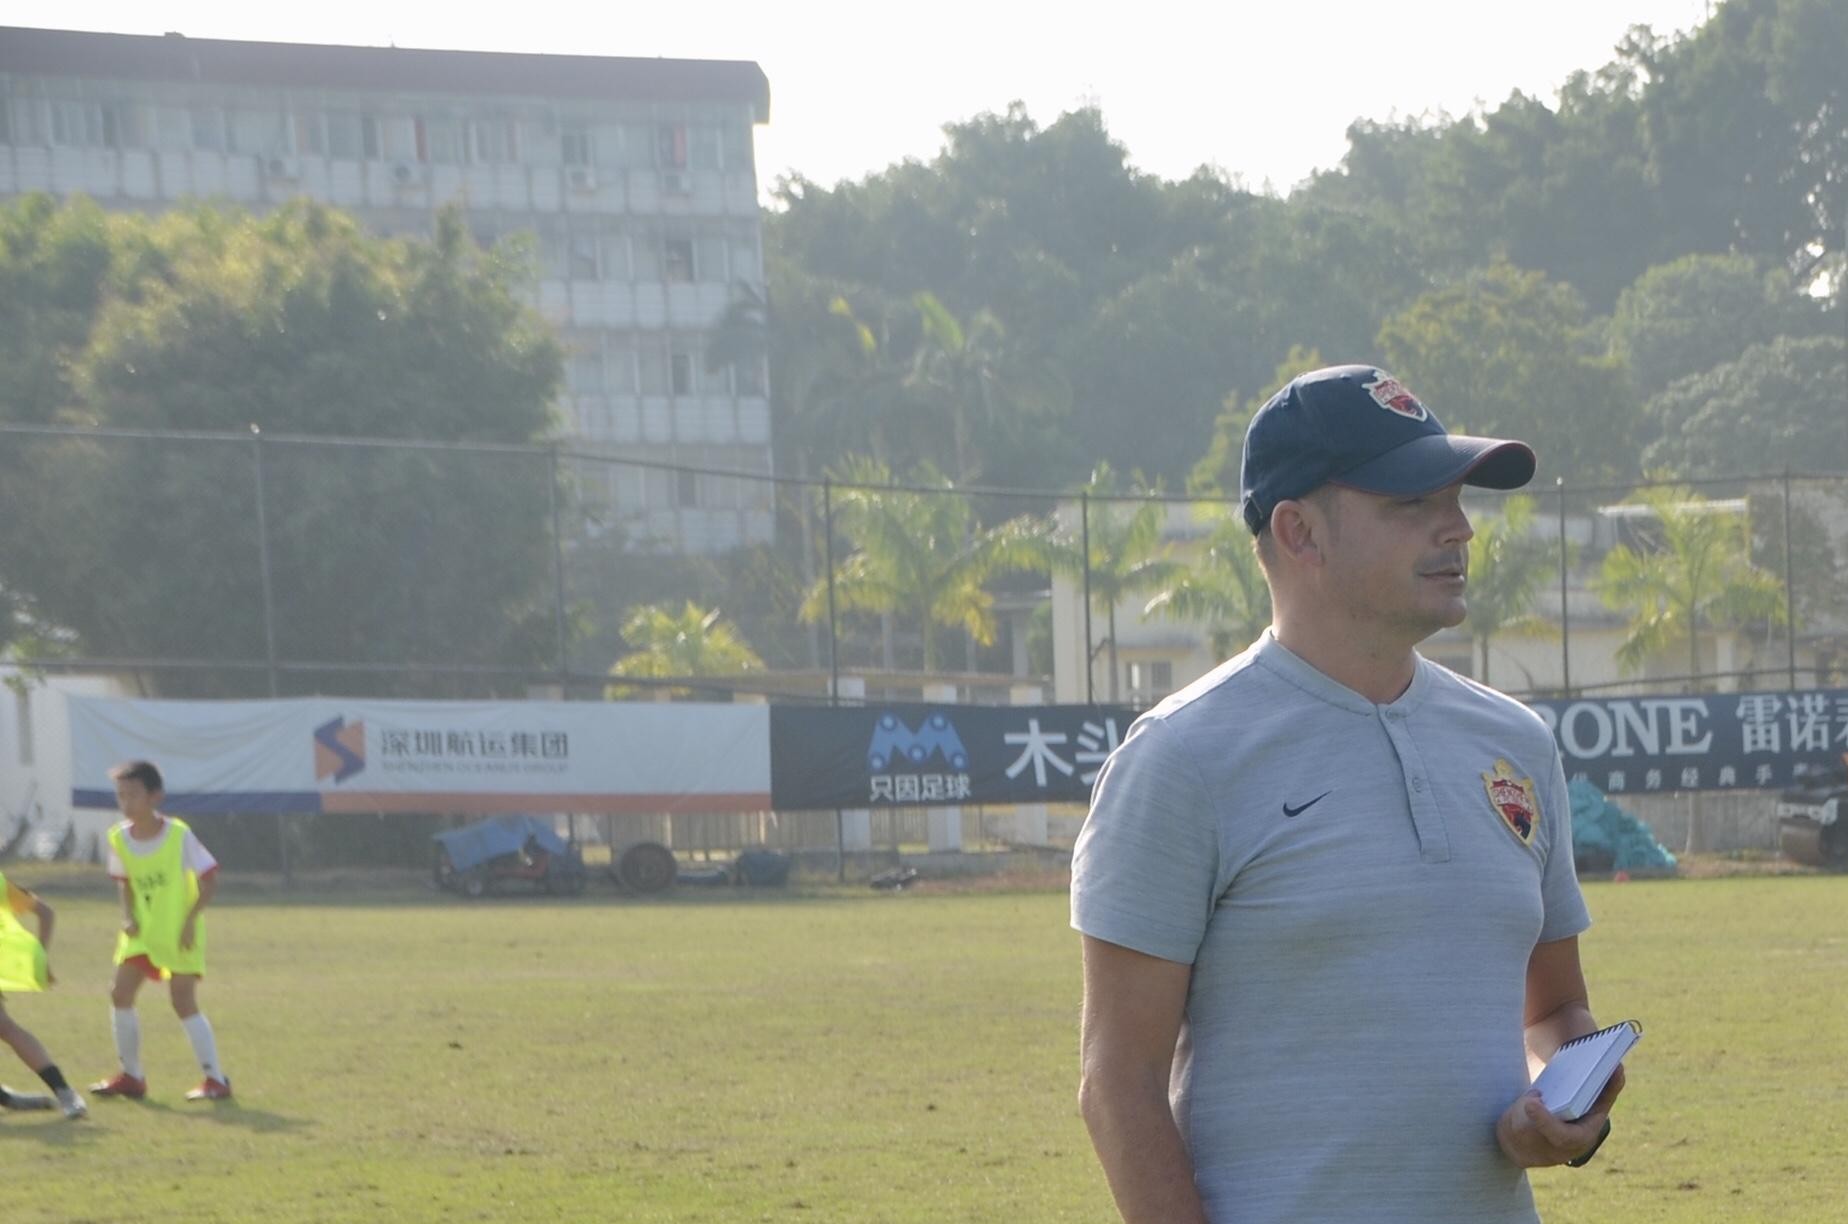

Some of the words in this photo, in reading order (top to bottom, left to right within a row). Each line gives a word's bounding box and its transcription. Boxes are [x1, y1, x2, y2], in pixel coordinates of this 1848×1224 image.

[381, 729, 569, 760] 深圳航运集团
[1004, 718, 1119, 787] 木头
